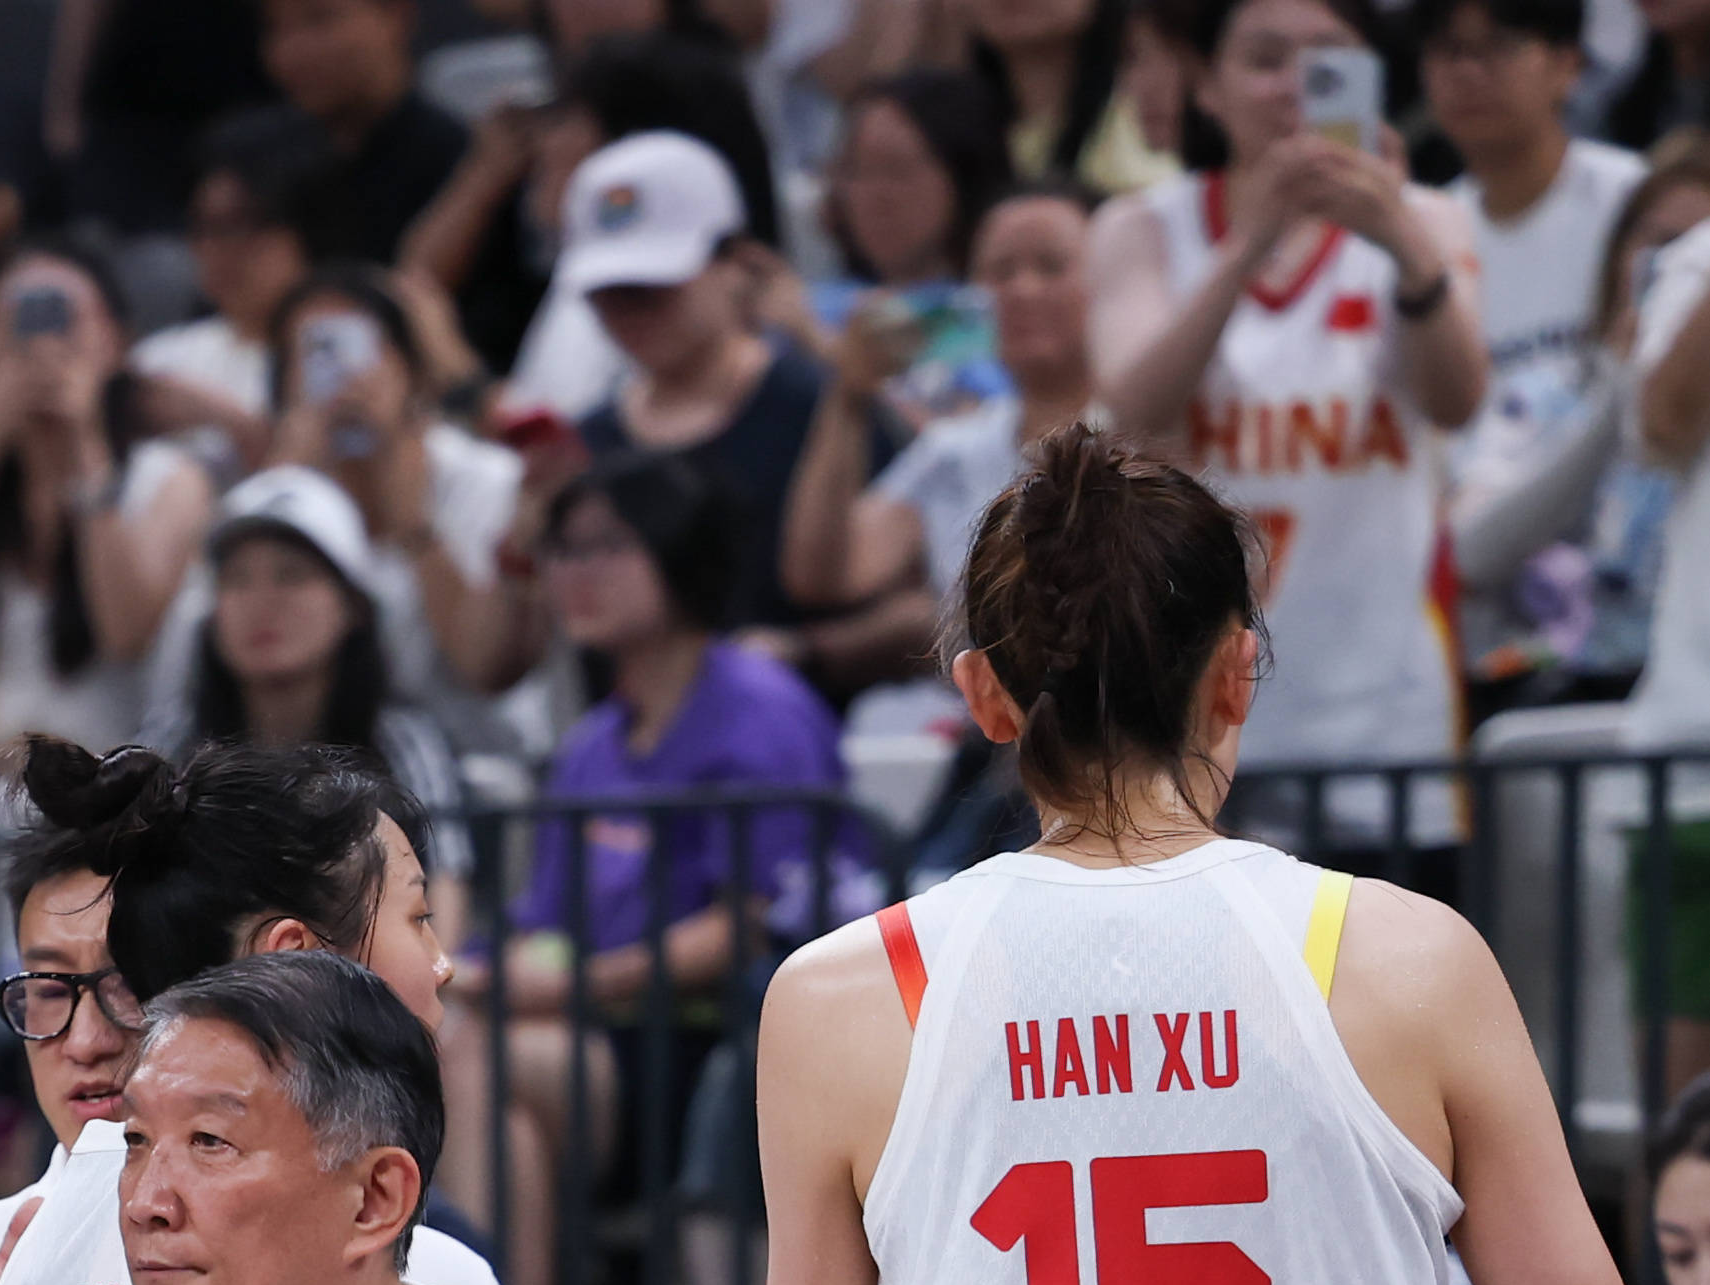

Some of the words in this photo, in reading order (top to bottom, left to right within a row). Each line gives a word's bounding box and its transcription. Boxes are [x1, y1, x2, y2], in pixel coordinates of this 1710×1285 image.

[1188, 398, 1411, 474] HINA
[1005, 1013, 1133, 1101] HAN
[1154, 1009, 1240, 1092] XU
